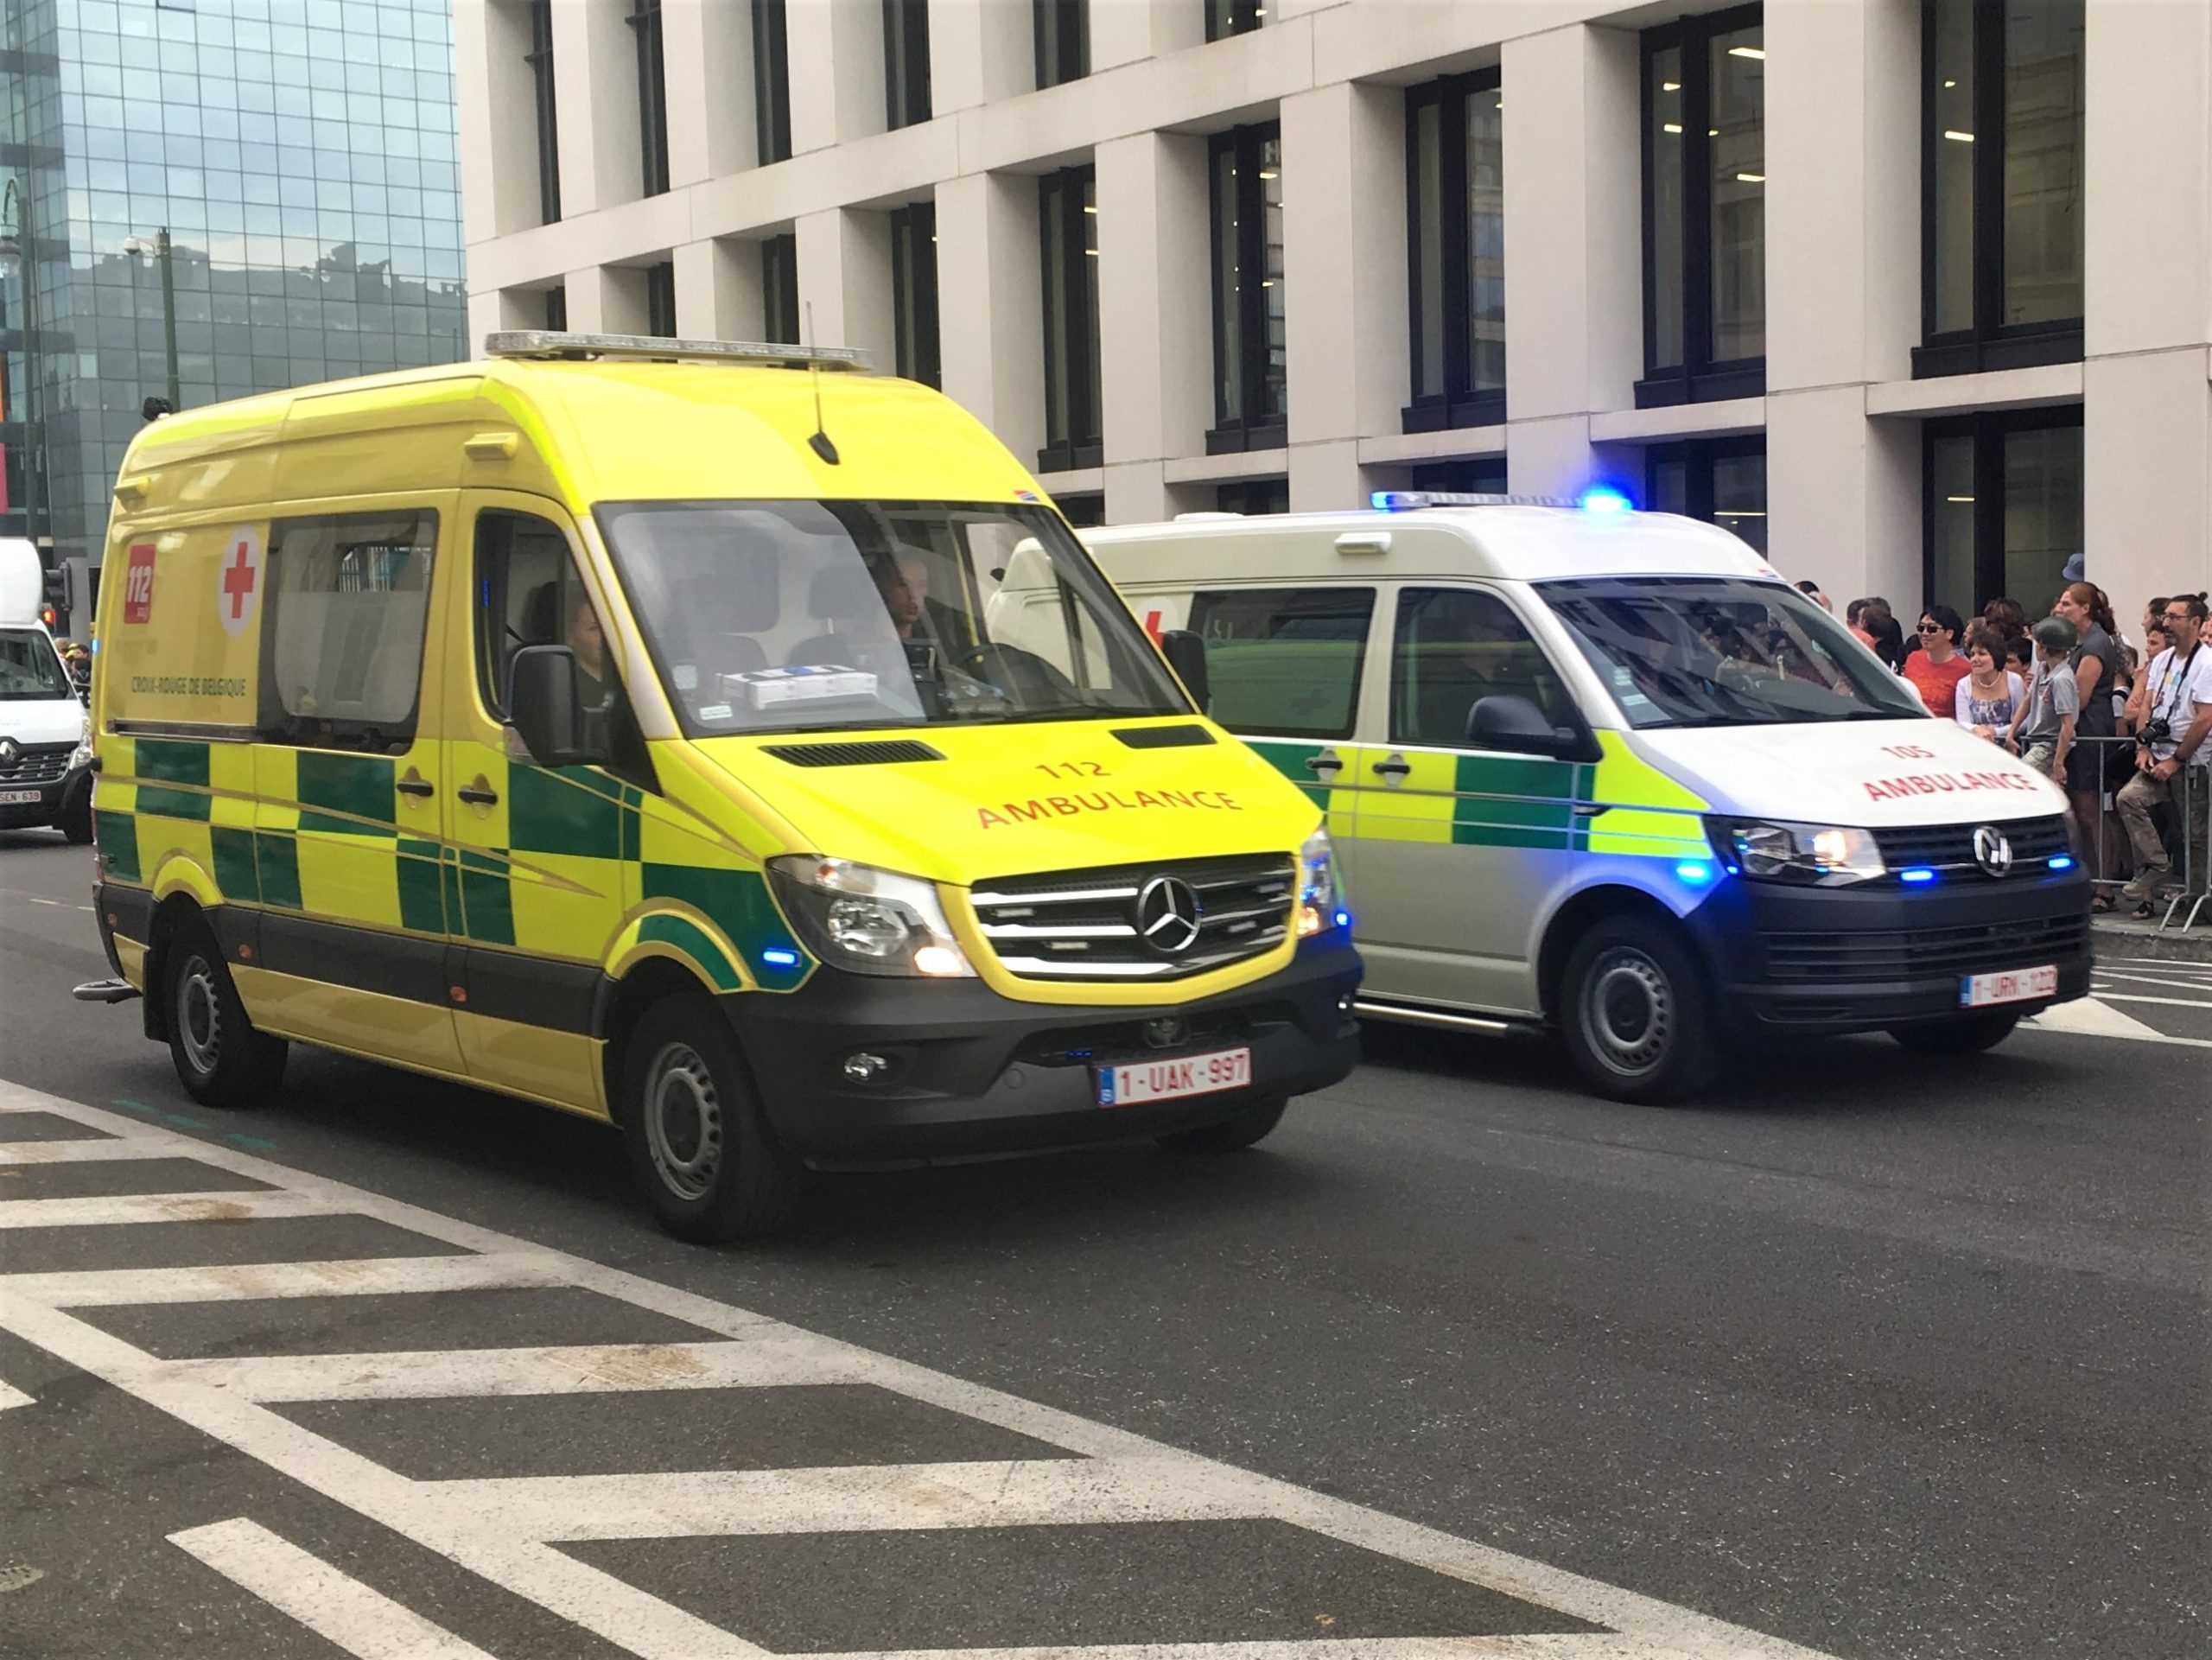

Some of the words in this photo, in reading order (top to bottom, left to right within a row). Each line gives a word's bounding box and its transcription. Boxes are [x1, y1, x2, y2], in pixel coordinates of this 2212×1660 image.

[128, 566, 152, 602] 112
[188, 677, 200, 695] DE
[201, 677, 246, 697] BELGIQUE
[1880, 745, 1936, 759] 105
[1035, 761, 1112, 779] 112
[1862, 773, 2038, 802] AMBULANCE
[977, 791, 1243, 830] AMBULANCE
[1120, 1053, 1245, 1097] 1-UAK-997
